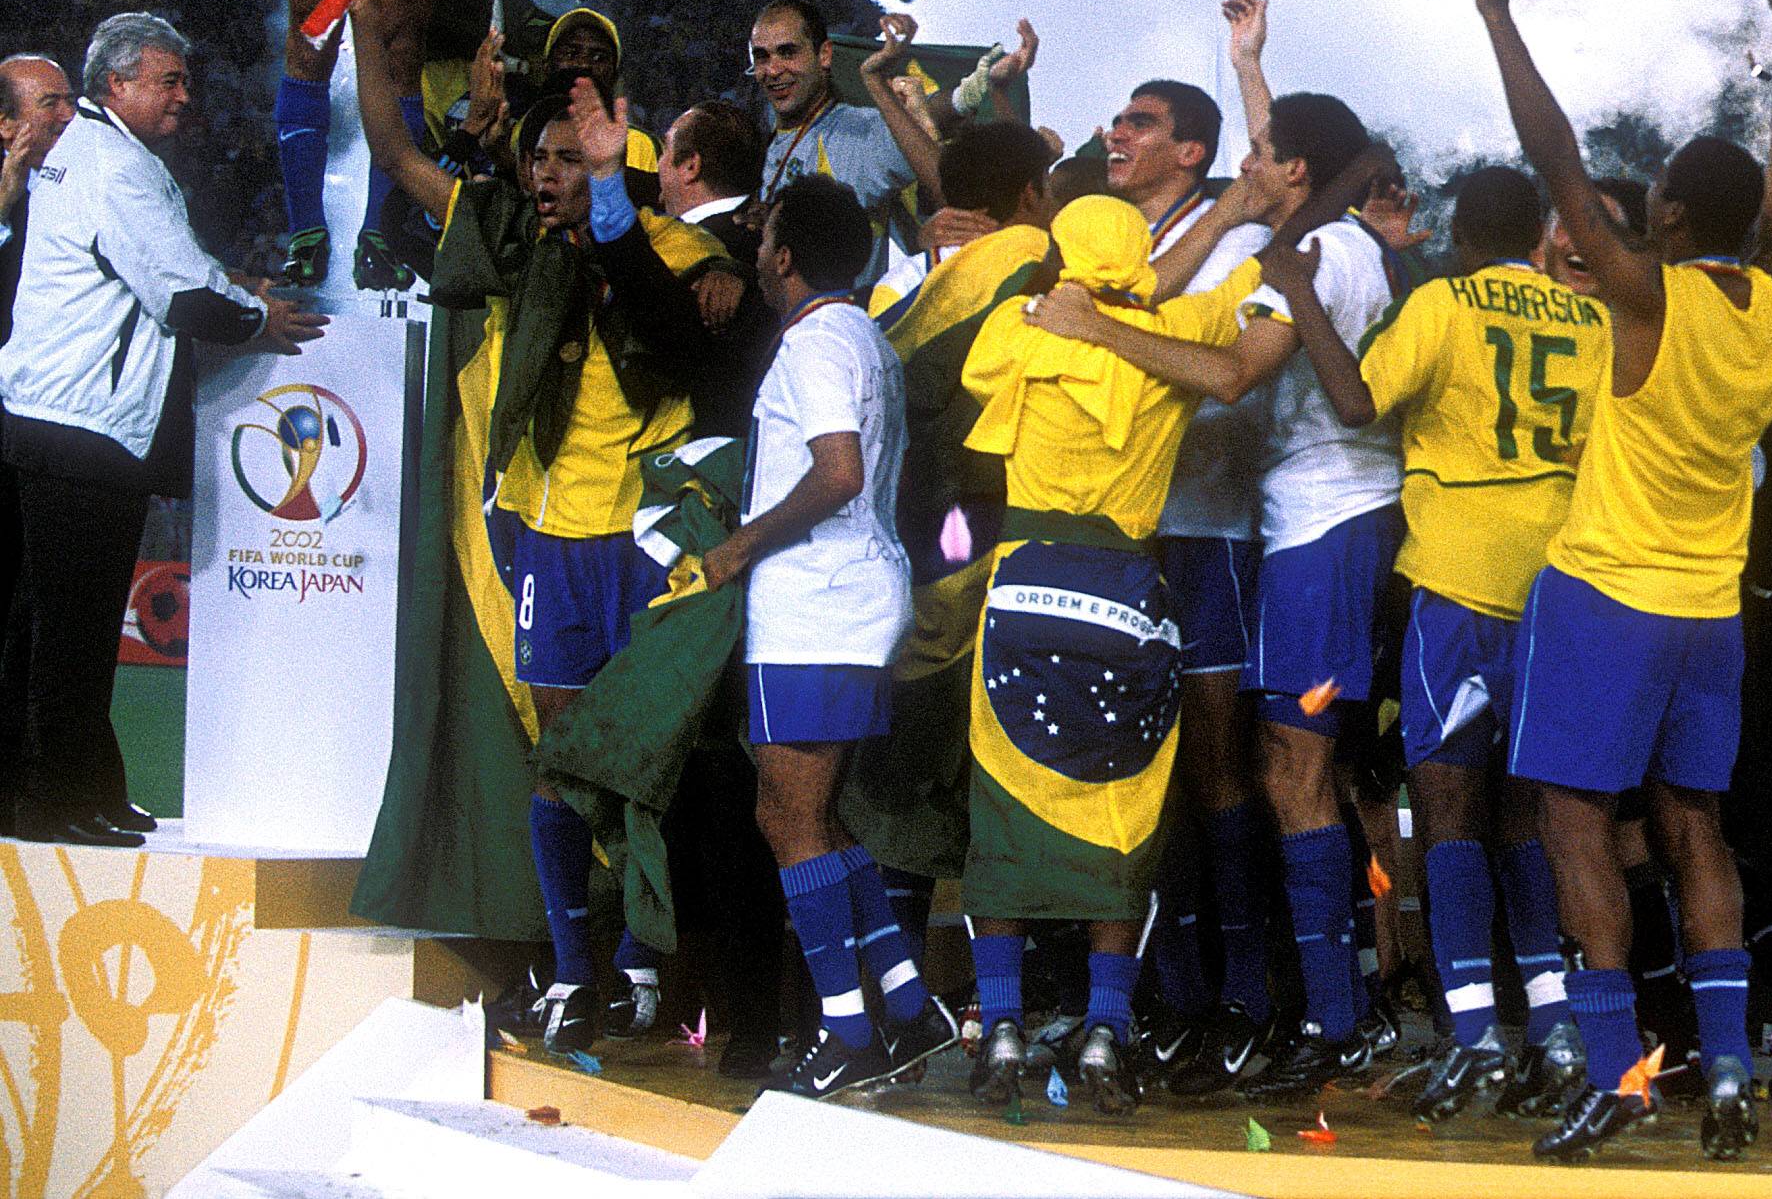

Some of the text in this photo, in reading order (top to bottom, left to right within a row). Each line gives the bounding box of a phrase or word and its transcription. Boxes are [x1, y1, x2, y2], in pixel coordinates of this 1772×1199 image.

[1485, 325, 1578, 465] 15
[270, 528, 323, 549] 2002
[228, 549, 365, 568] FIFA WORLD CUP
[228, 565, 364, 603] KOREA JAPAN
[519, 573, 535, 630] 8
[1015, 591, 1082, 610] ORDEM
[1090, 602, 1100, 614] E
